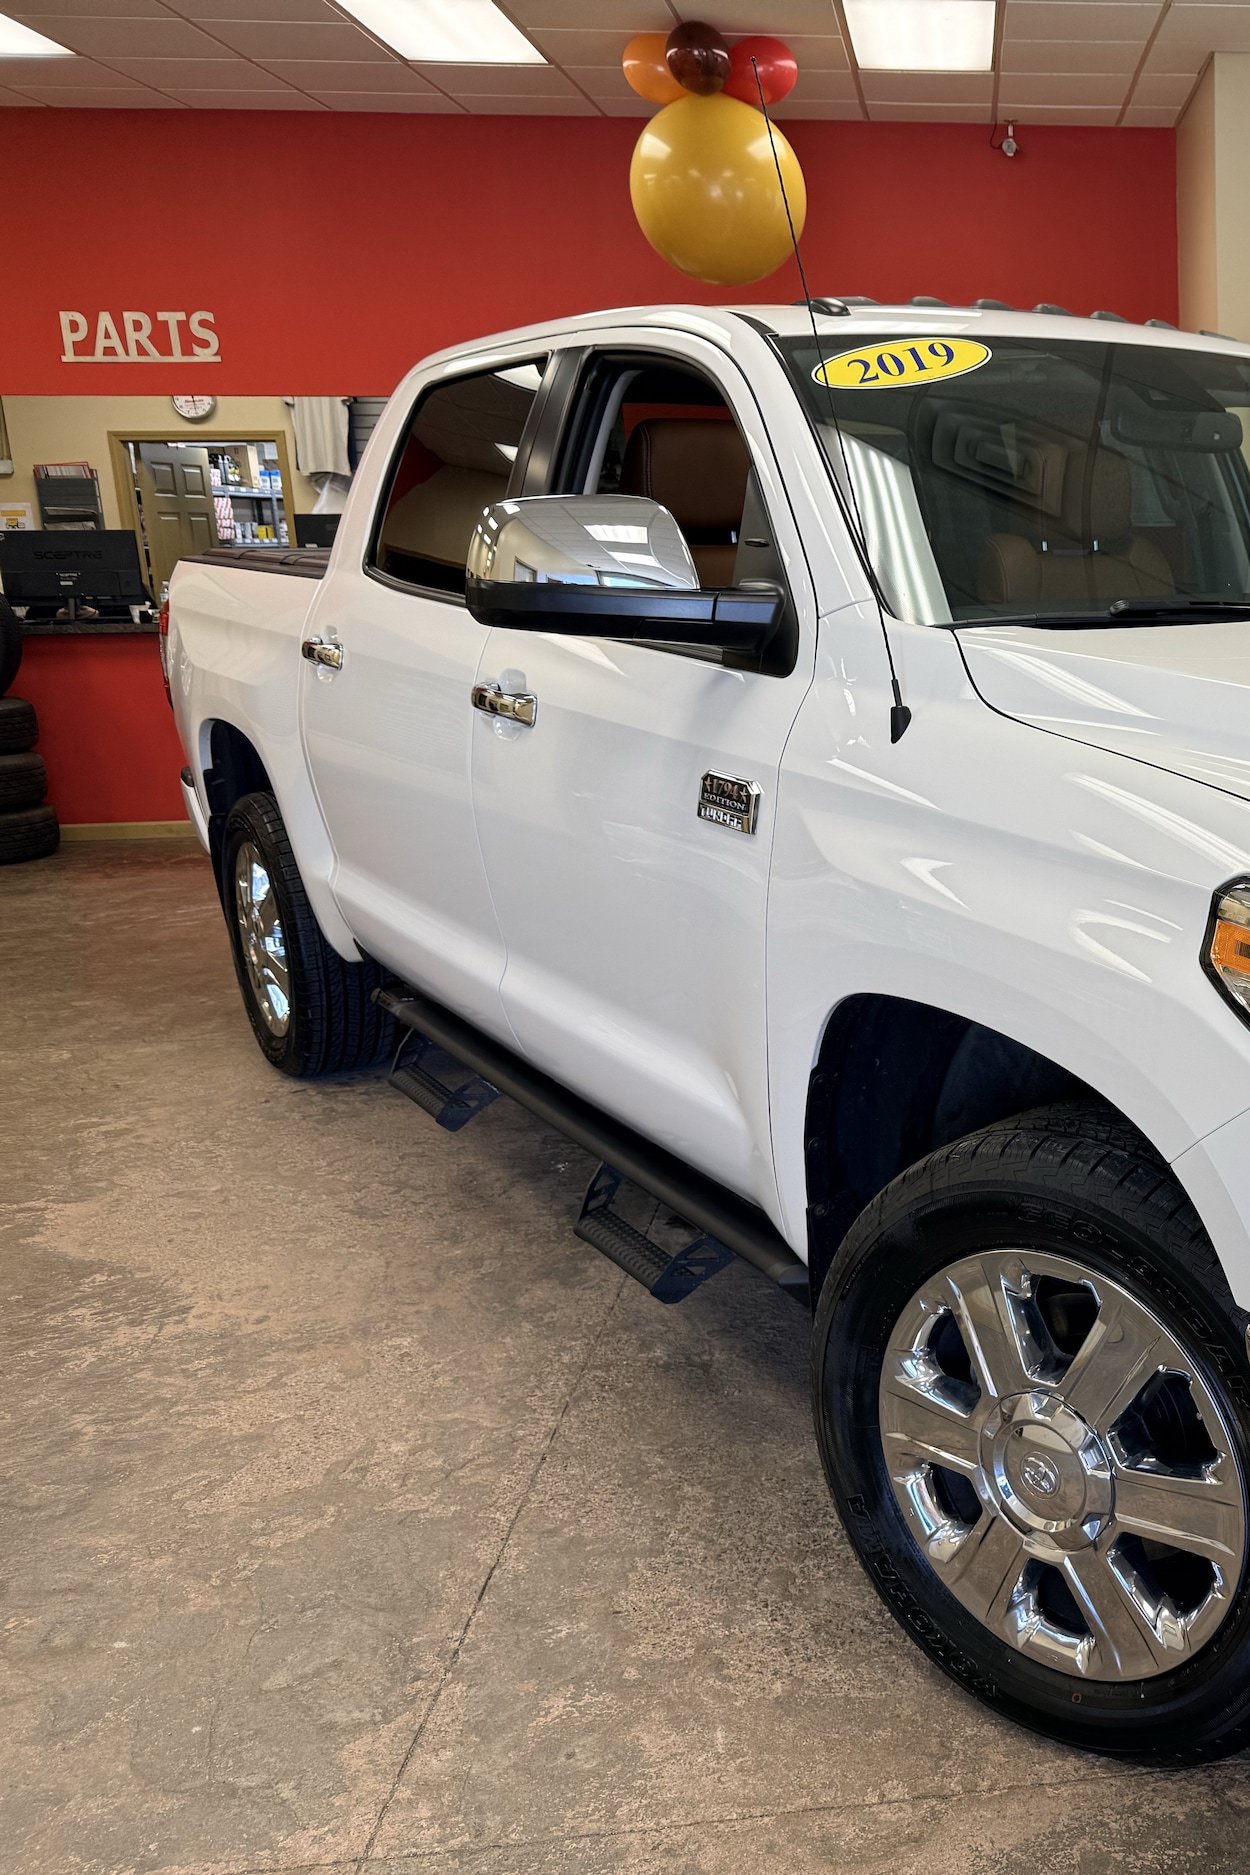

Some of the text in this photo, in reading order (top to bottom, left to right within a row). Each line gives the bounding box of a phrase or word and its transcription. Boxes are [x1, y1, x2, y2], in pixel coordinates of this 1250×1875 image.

[59, 310, 221, 359] PARTS
[847, 342, 955, 384] 2019
[703, 792, 746, 811] EDITION
